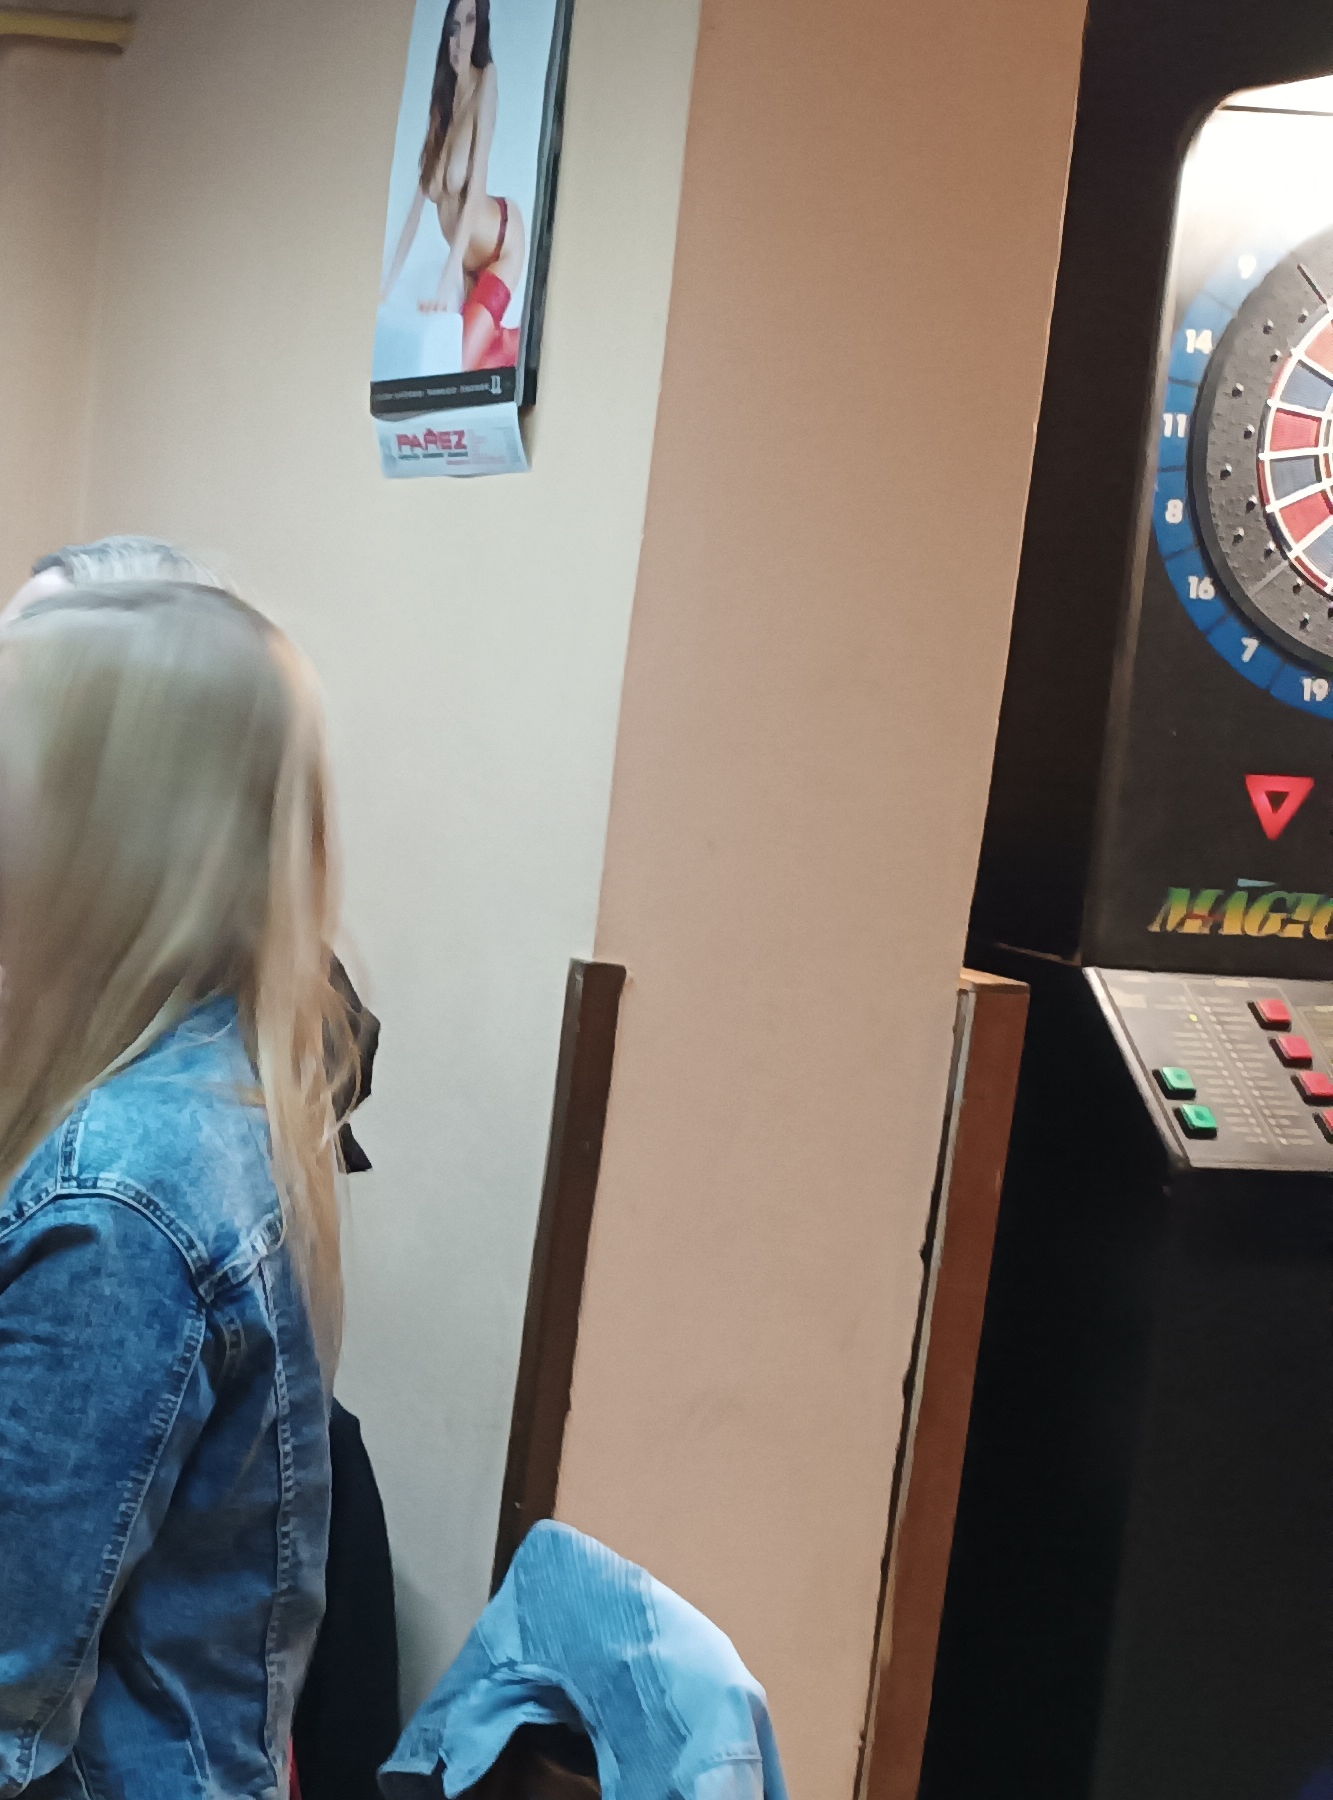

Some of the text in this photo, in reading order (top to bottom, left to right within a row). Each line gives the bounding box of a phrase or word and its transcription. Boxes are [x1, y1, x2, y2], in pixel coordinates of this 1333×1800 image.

[1237, 254, 1257, 280] 9
[1185, 329, 1213, 355] 14
[1162, 413, 1188, 439] 11
[1164, 499, 1184, 525] 8
[1187, 576, 1217, 602] 16
[1240, 637, 1260, 664] 7
[1301, 677, 1331, 703] 19
